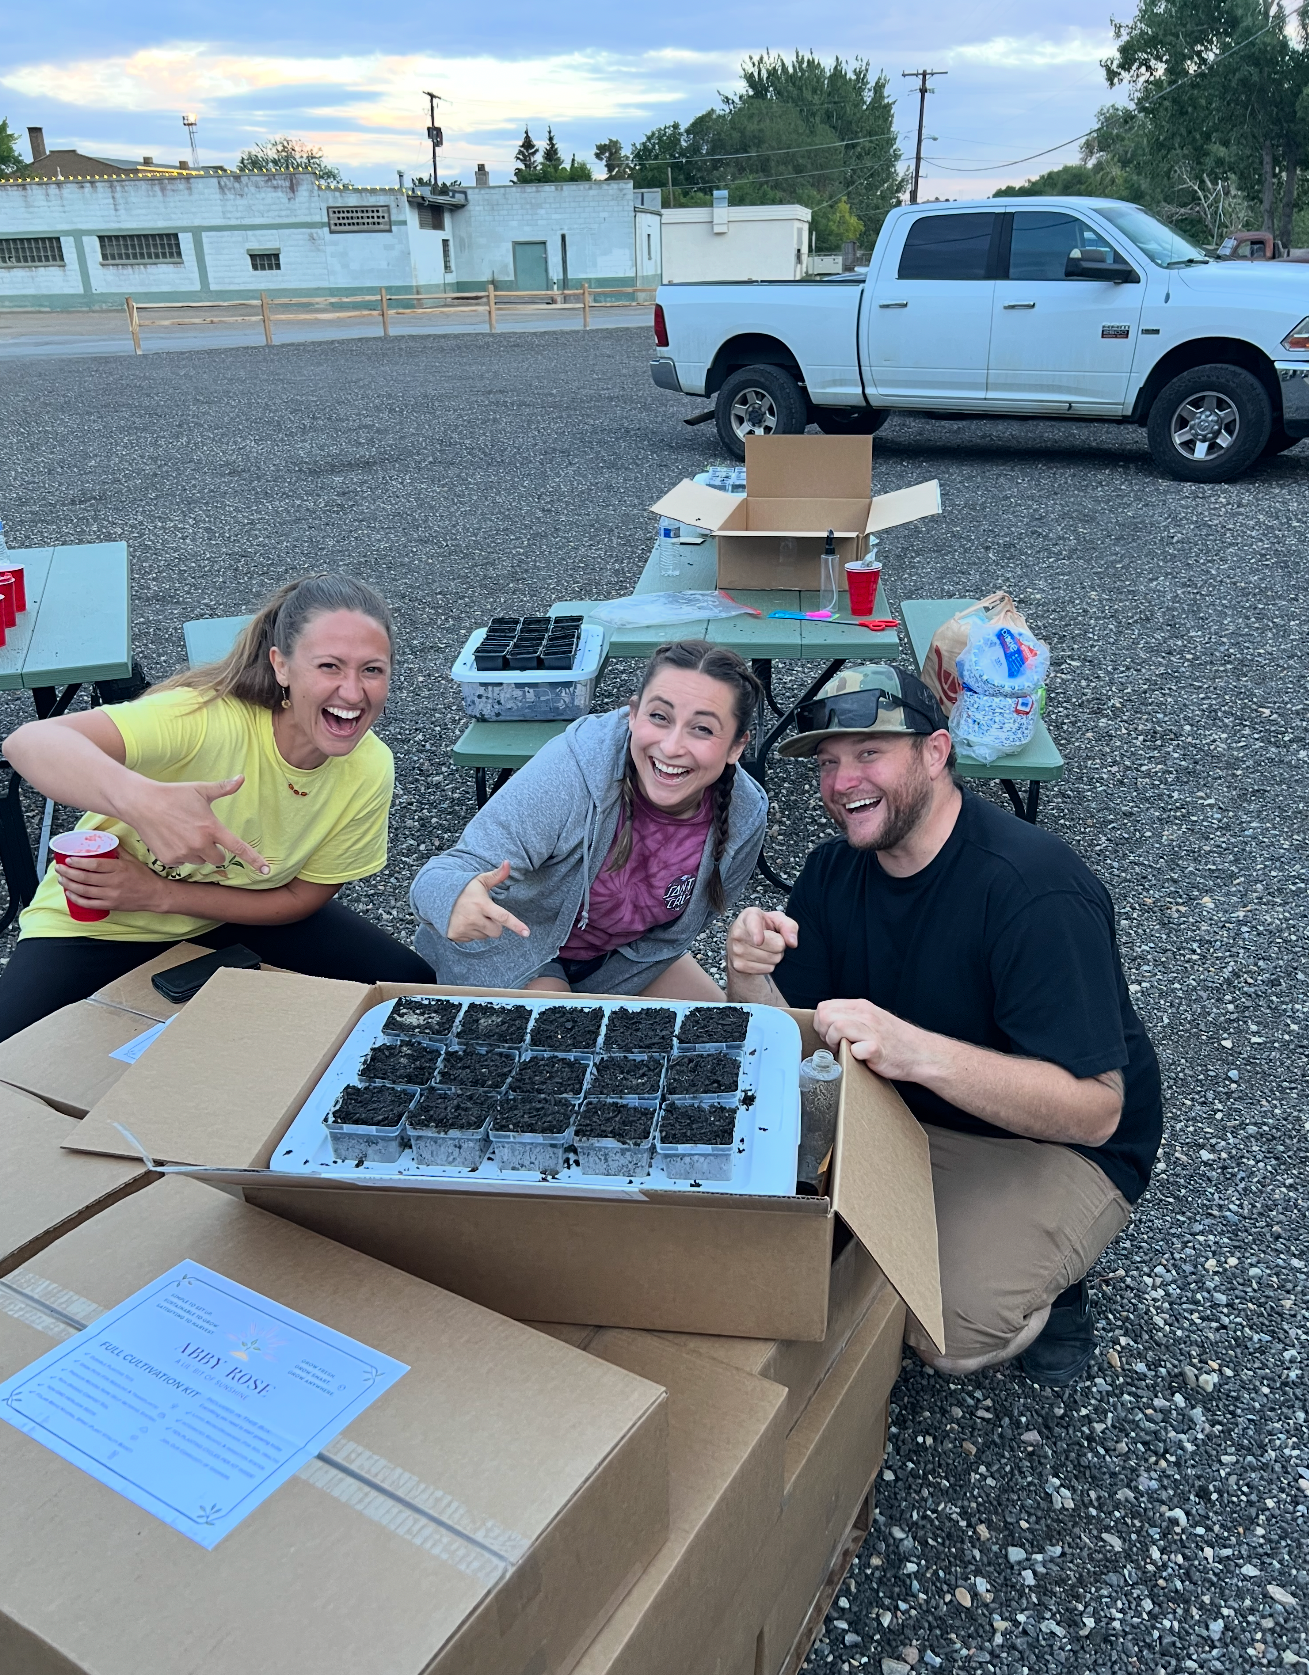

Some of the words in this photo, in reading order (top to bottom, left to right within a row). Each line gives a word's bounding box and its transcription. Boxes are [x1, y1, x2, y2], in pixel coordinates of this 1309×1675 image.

[164, 1298, 196, 1316] SUSTAINABLE
[171, 1293, 190, 1304] SIMPLE
[156, 1303, 185, 1320] SATISFYING
[99, 1341, 124, 1357] FULL
[123, 1354, 185, 1389] CULTIVATION
[181, 1386, 202, 1398] KIT
[174, 1342, 228, 1369] ABBY
[225, 1367, 276, 1398] ROSE
[295, 1365, 312, 1374] GROW
[301, 1359, 319, 1369] GROW
[288, 1370, 305, 1380] GROW
[193, 1368, 205, 1376] BIT
[215, 1380, 250, 1400] SUNSHINE
